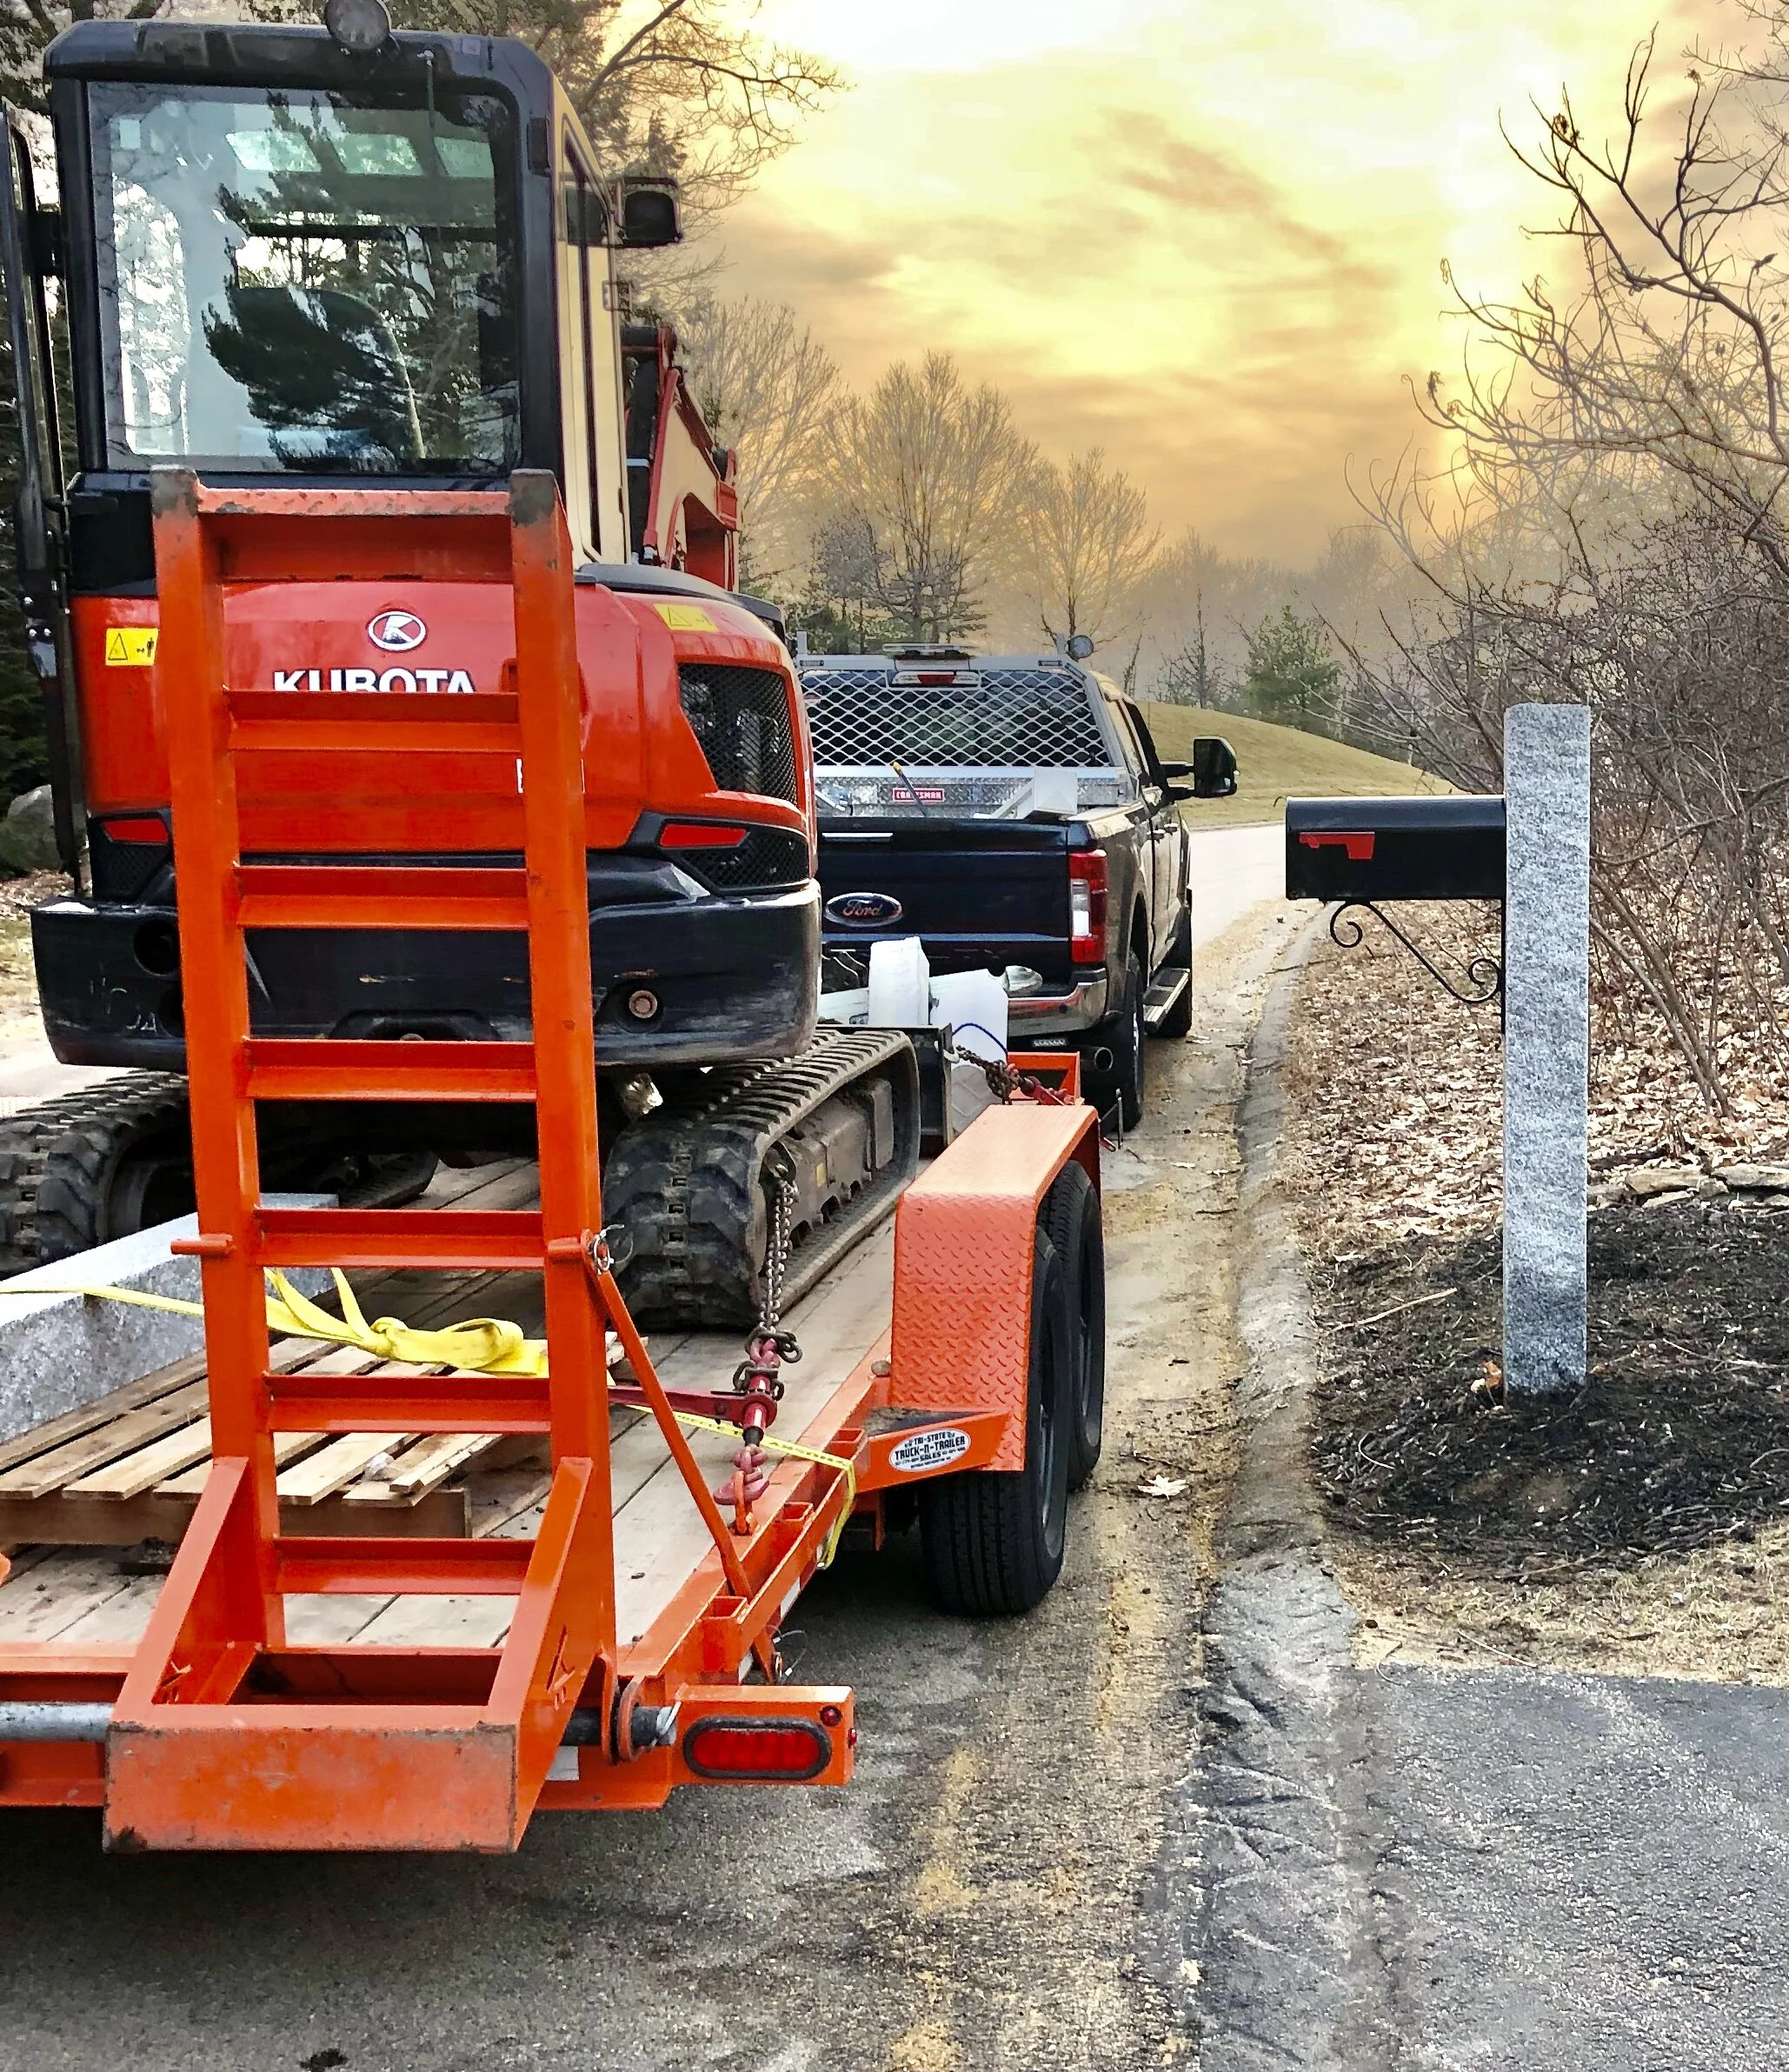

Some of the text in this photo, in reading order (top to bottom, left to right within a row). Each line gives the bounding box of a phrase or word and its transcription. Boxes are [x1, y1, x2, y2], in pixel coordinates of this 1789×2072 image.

[274, 668, 475, 693] KUBOTA
[842, 898, 884, 917] Ford
[914, 1431, 946, 1445] TRI-STATE
[894, 1436, 966, 1461] TRUCK-N-TRAILER
[920, 1450, 941, 1462] SALES
